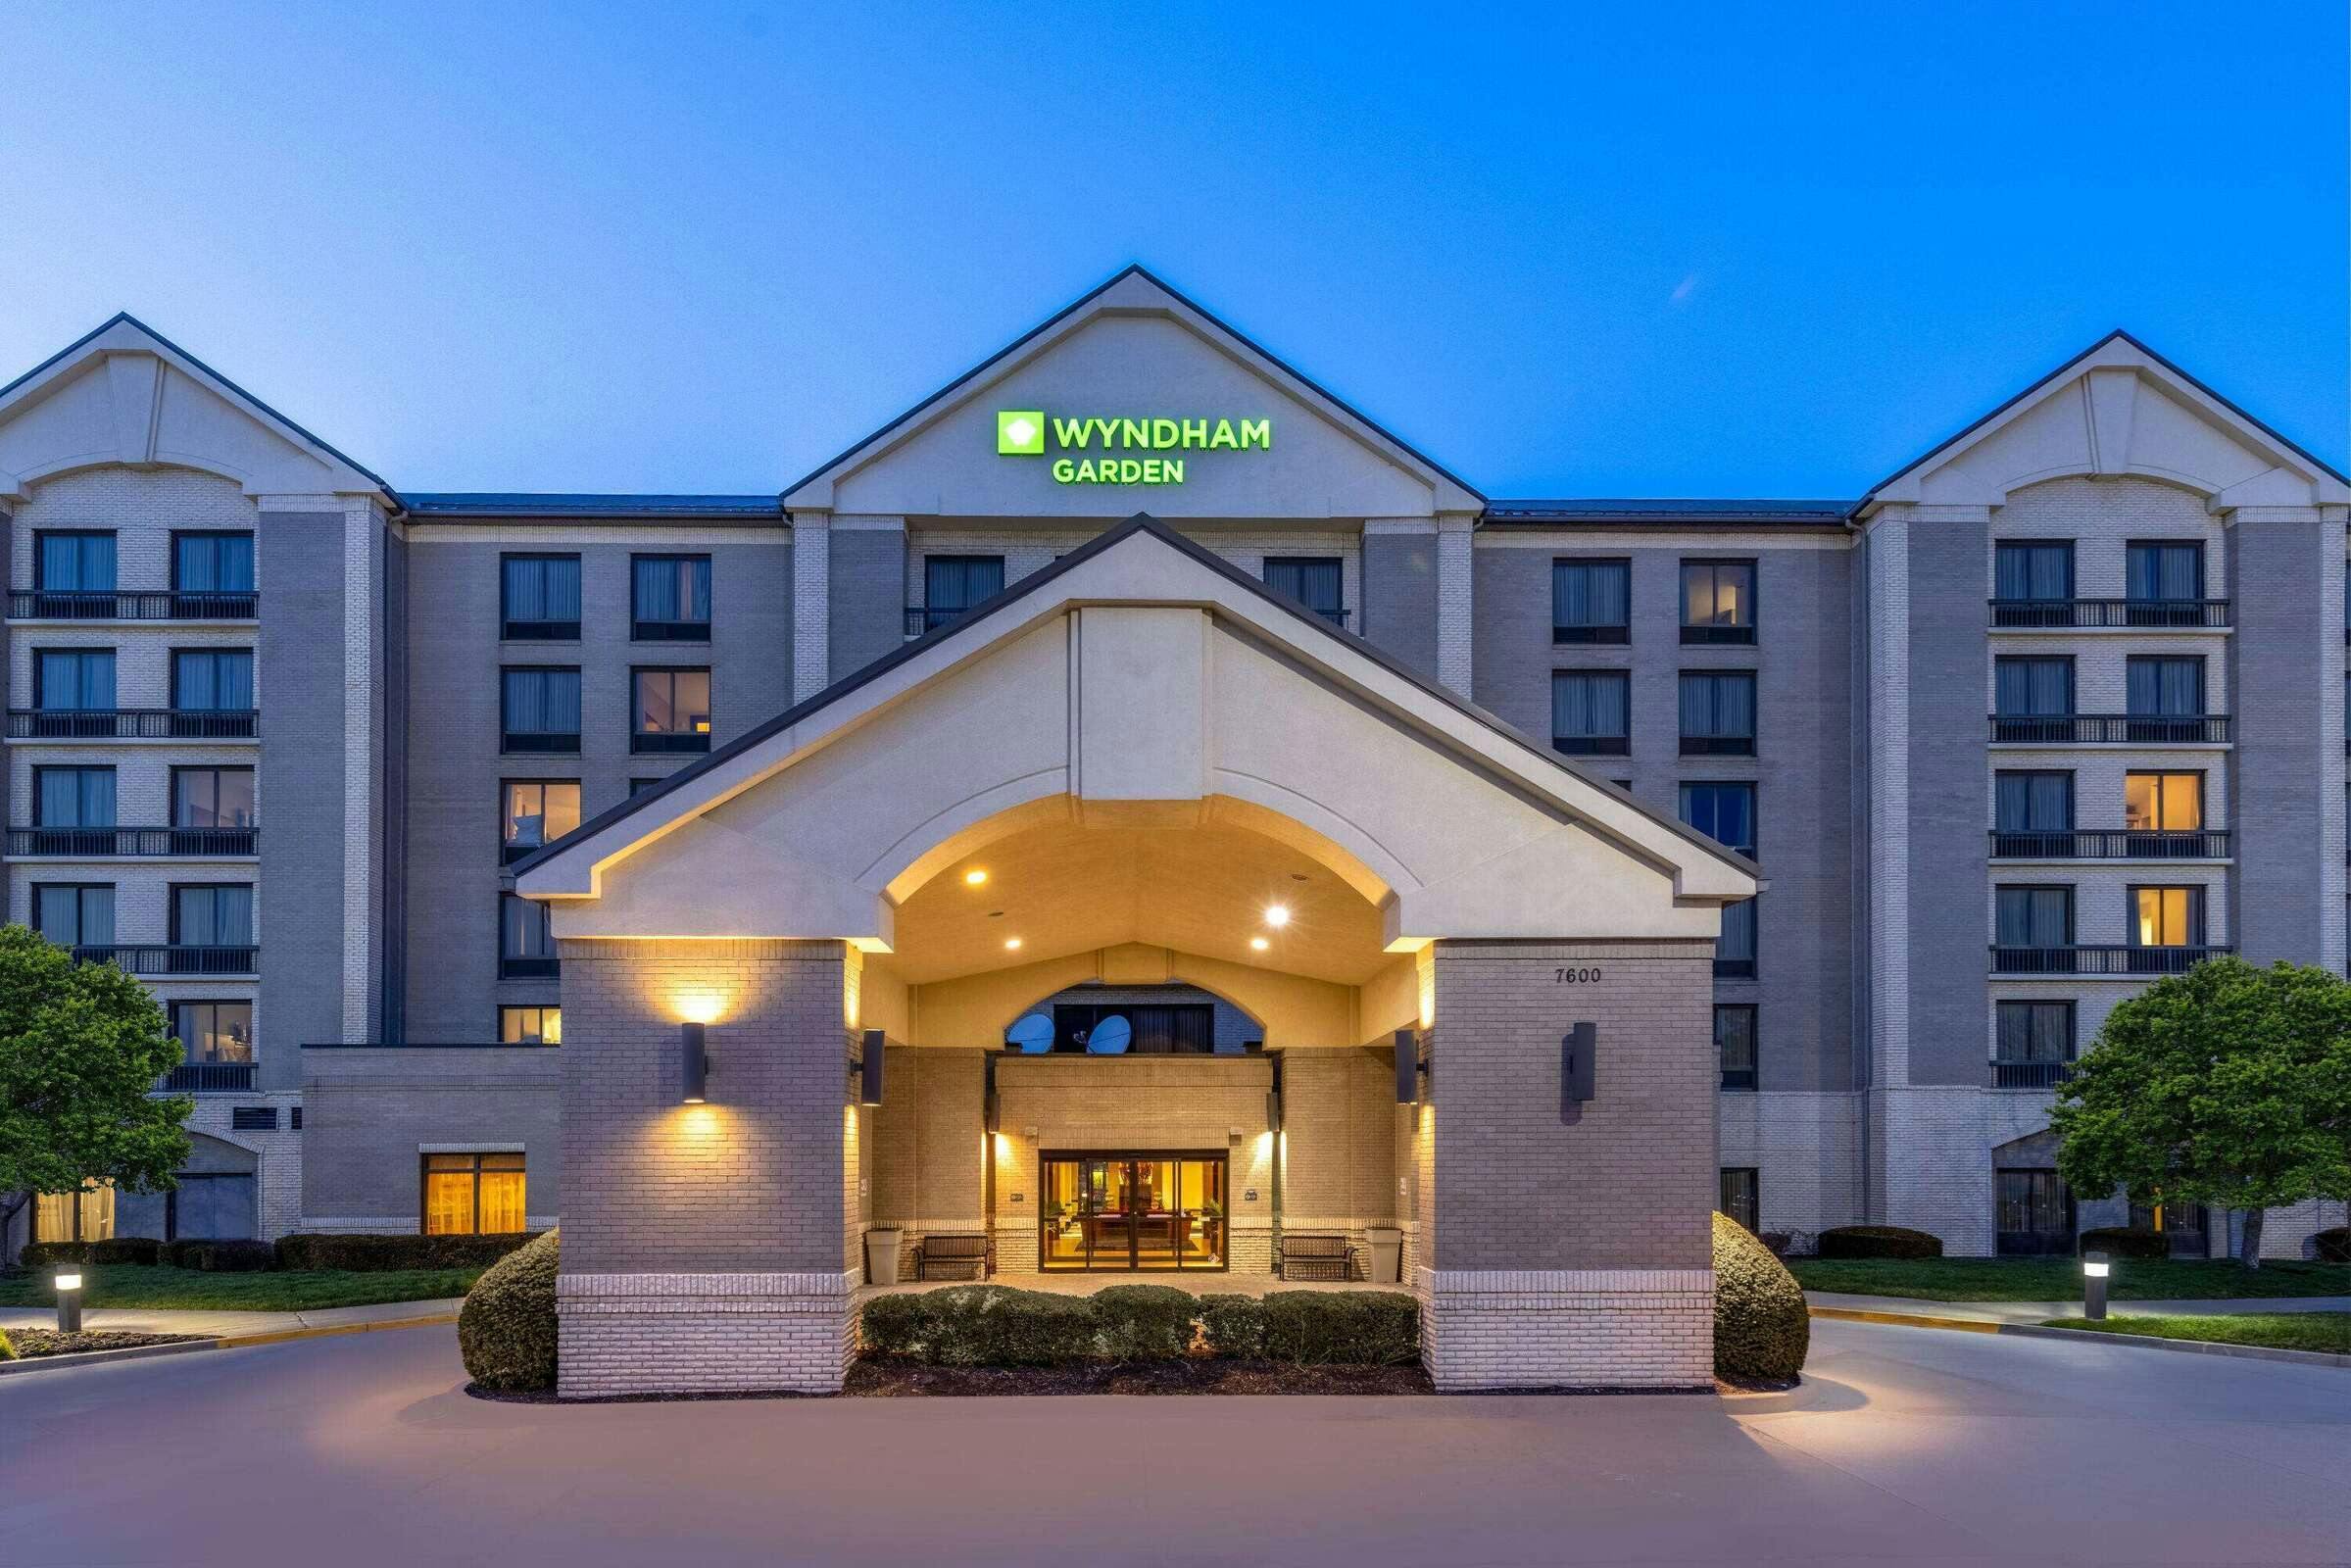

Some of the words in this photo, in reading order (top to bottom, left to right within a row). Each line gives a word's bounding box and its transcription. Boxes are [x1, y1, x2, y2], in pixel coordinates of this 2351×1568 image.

[1053, 418, 1271, 450] WYNDHAM
[1052, 459, 1185, 484] GARDEN
[1555, 967, 1601, 984] 7600
